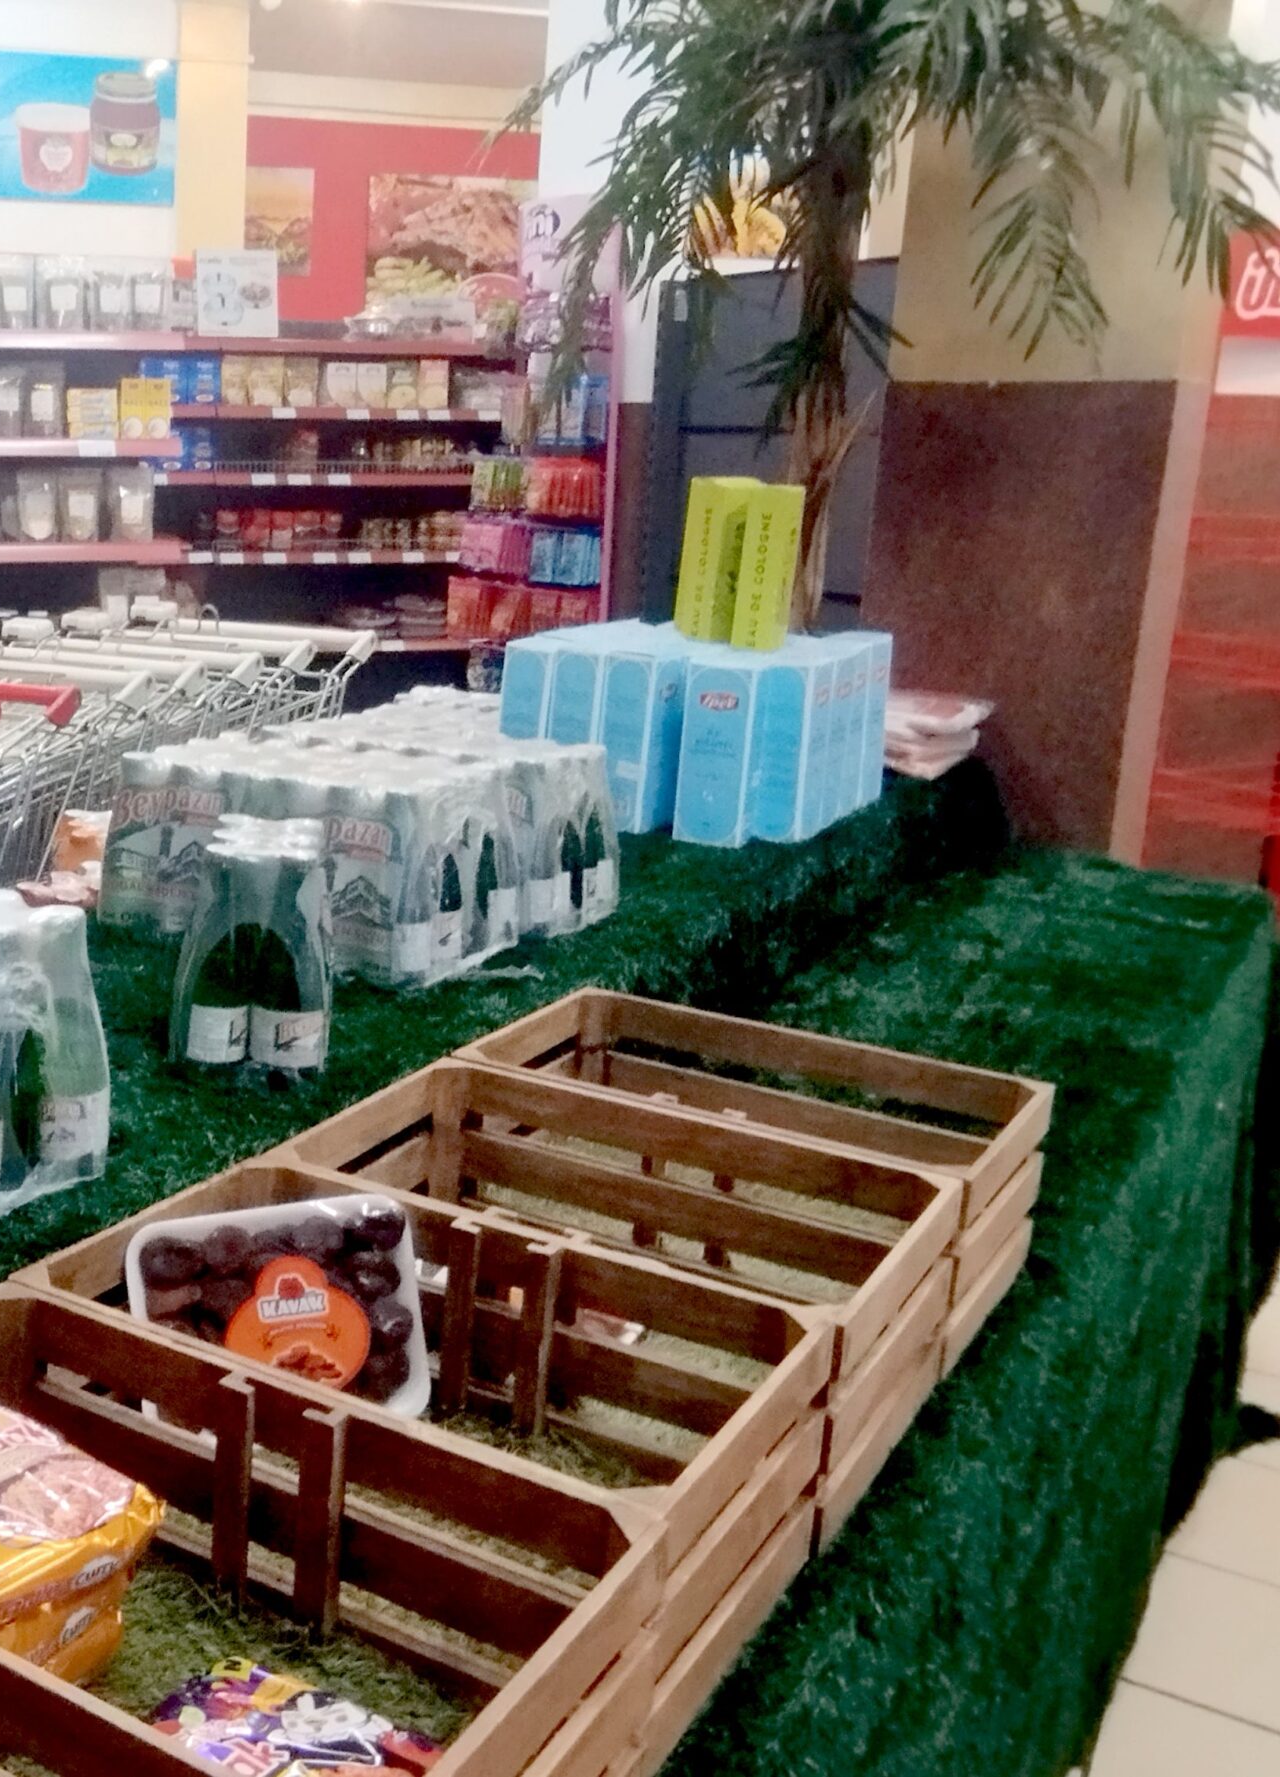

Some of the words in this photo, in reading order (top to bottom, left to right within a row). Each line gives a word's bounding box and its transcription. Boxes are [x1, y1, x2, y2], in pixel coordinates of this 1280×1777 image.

[753, 512, 773, 586] COLOGNE
[750, 593, 763, 612] DE
[261, 1293, 326, 1320] KAVAK
